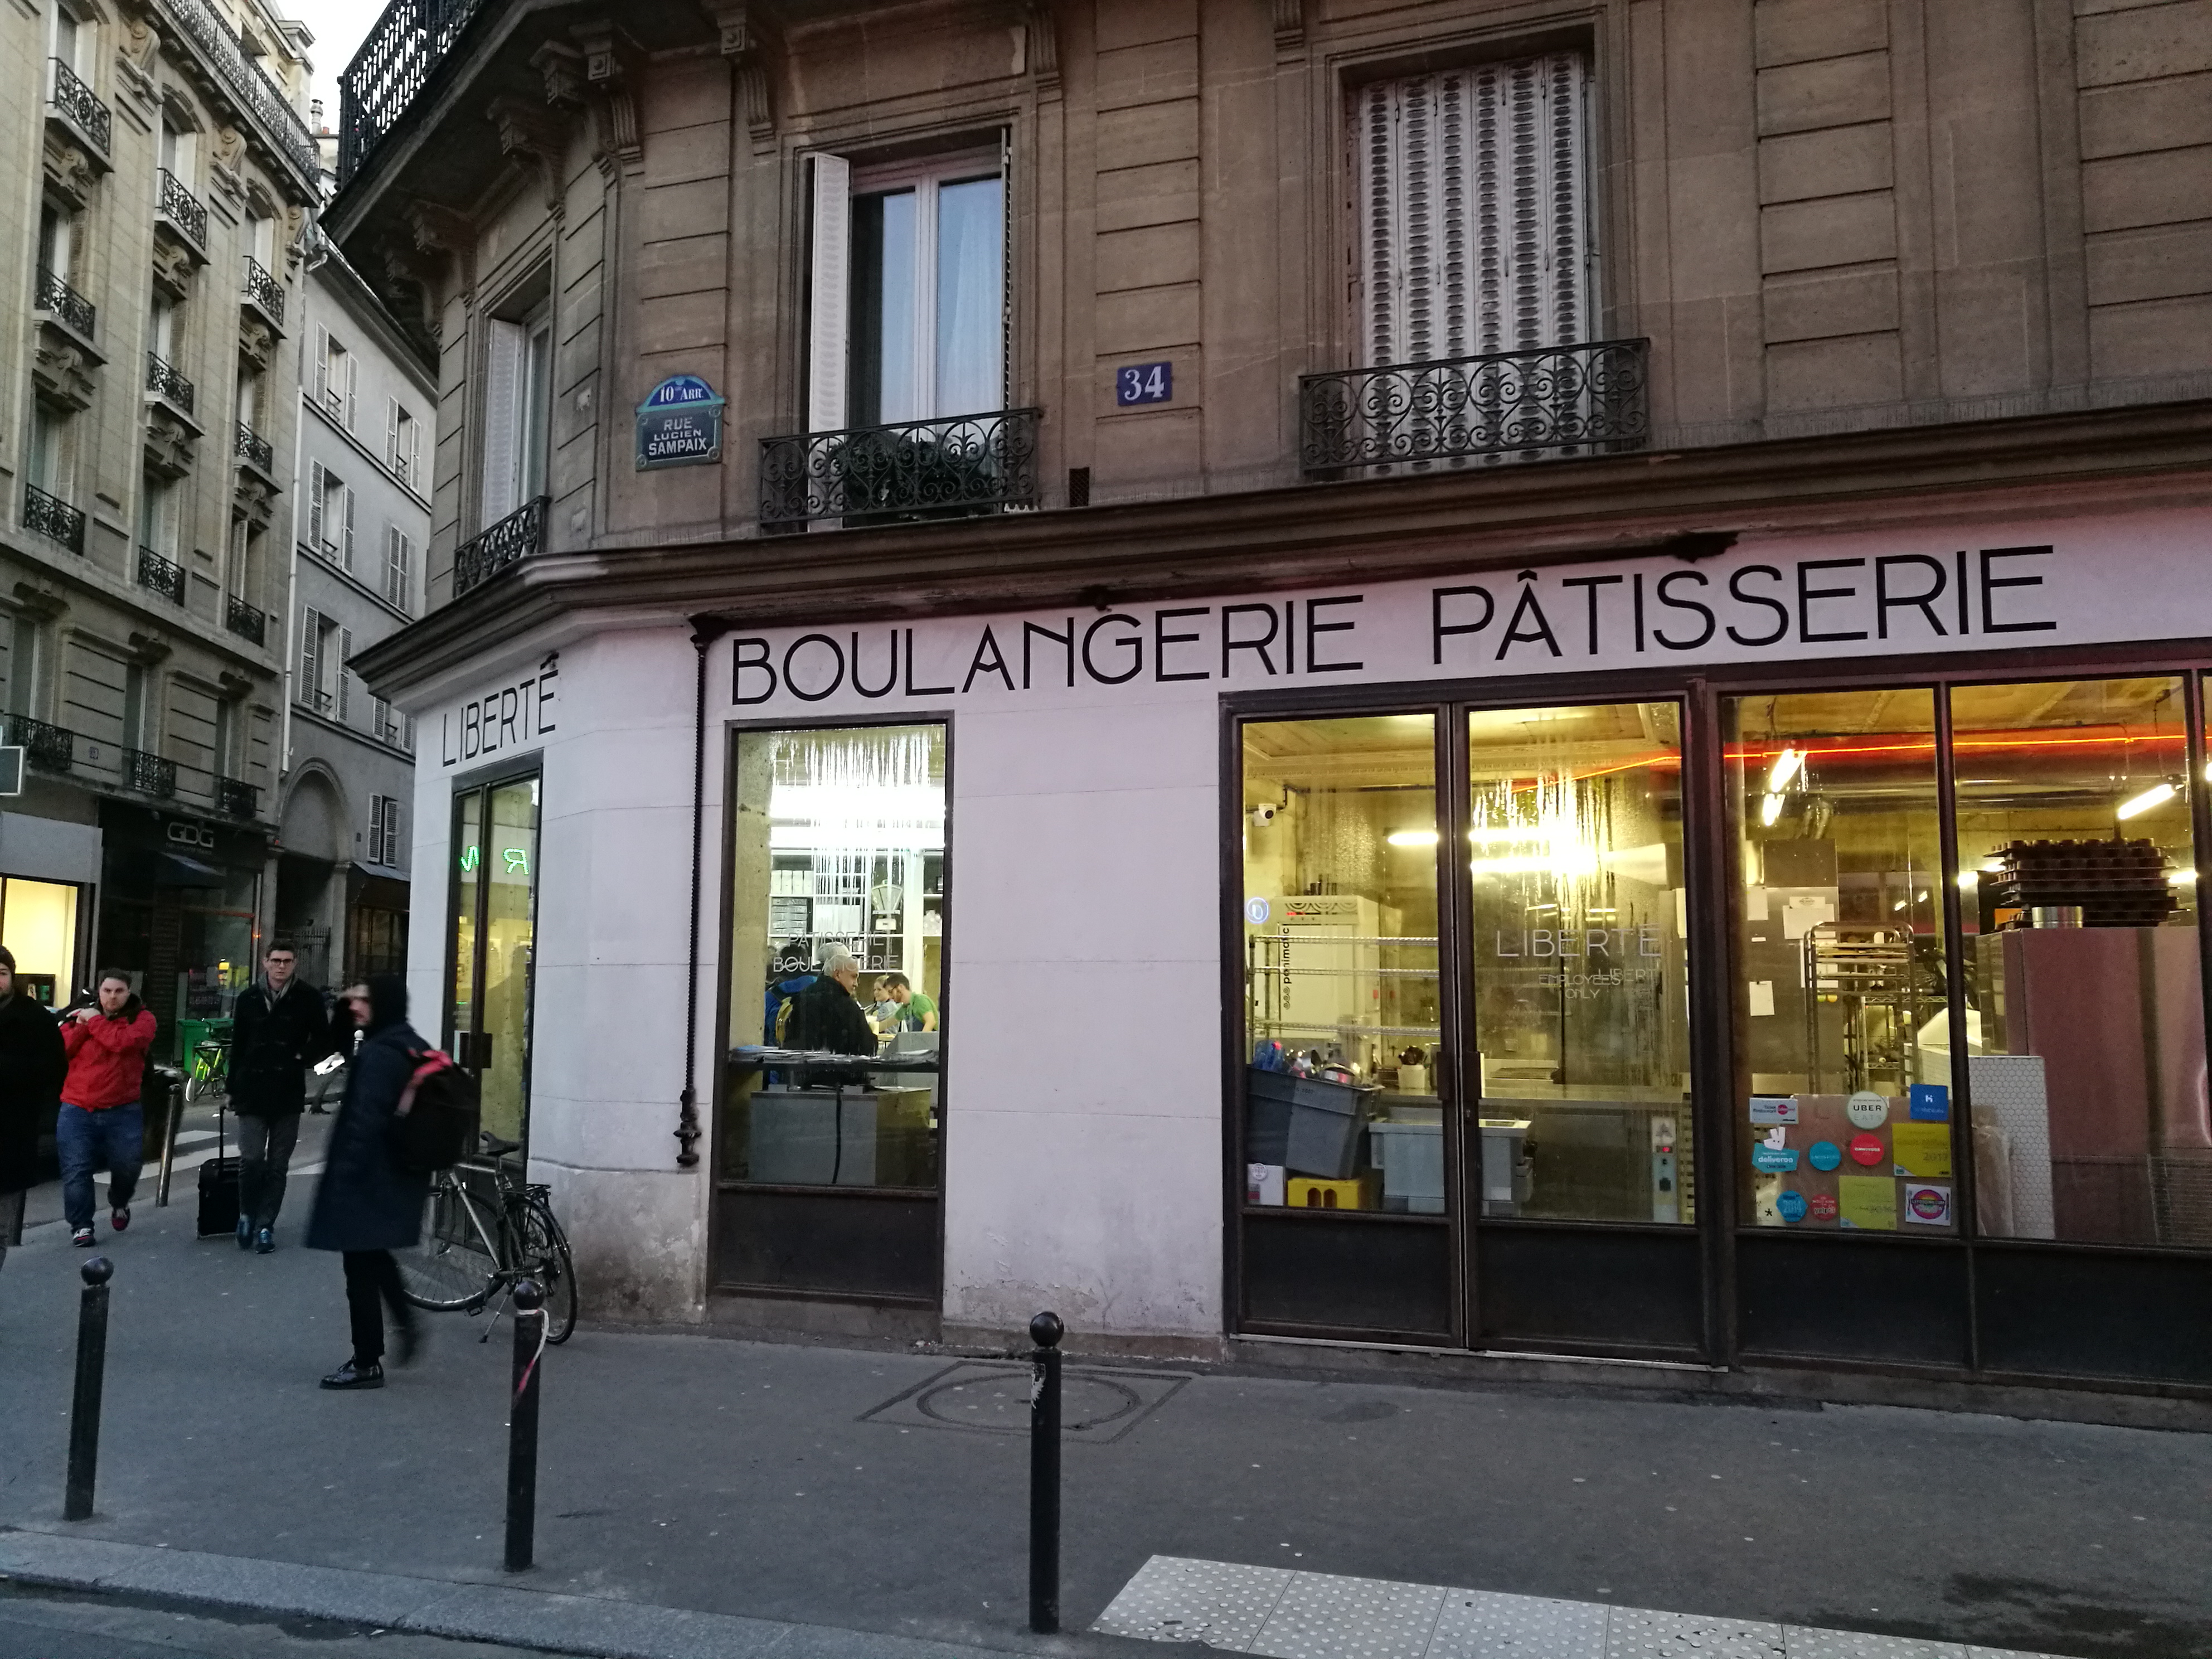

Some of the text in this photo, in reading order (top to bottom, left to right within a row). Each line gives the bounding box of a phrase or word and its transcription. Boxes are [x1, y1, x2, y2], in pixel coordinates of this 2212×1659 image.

[1124, 366, 1165, 401] 34
[664, 417, 692, 431] RUE
[654, 429, 702, 442] LUCIEN
[649, 438, 707, 456] SAMPAIX
[732, 544, 2057, 706] BOULANGERIE PÂTISSERIE
[443, 653, 559, 767] LIBERTÉ
[167, 822, 214, 848] GDG
[1497, 923, 1661, 957] LIBERTÉ
[1539, 974, 1621, 985] EMPLOYEES
[1565, 988, 1600, 998] ONLY
